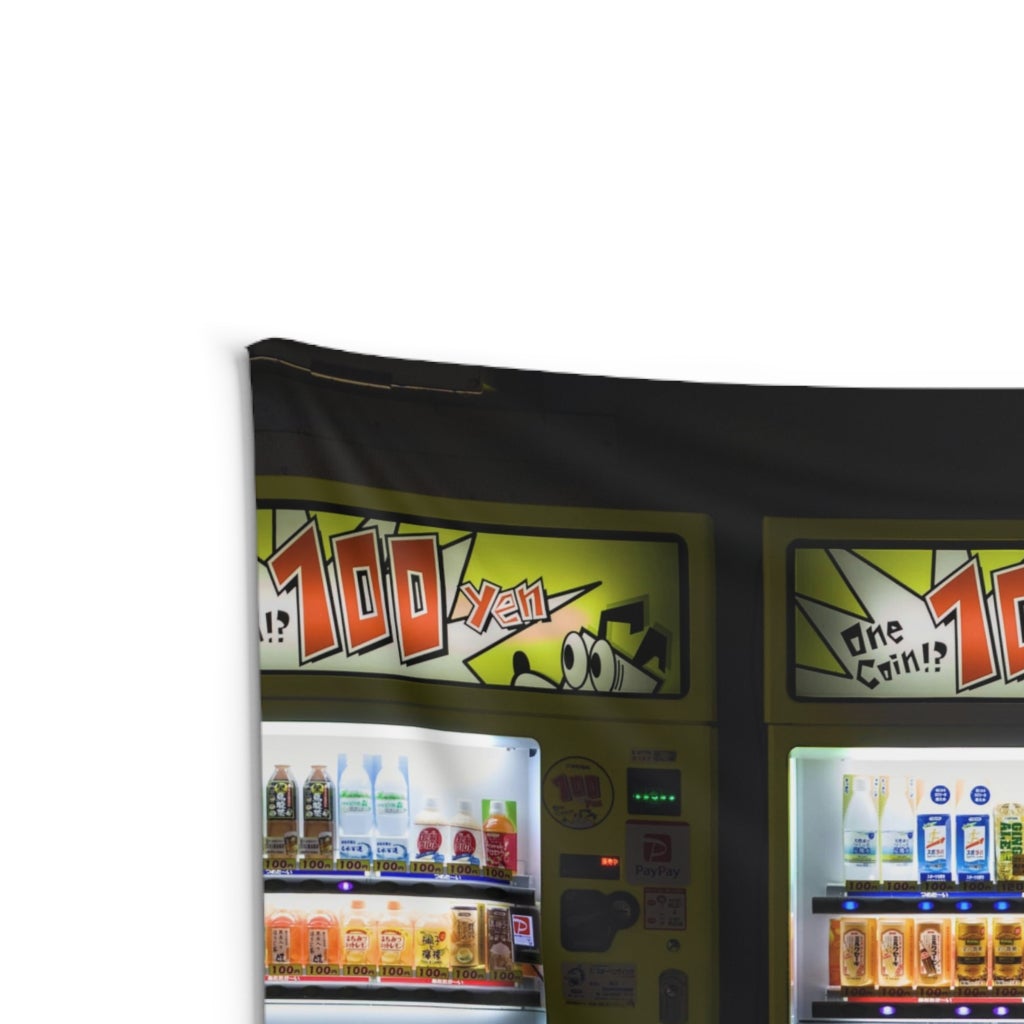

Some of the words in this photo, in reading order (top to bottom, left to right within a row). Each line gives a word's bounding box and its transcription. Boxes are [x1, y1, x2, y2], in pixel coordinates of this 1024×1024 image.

[266, 514, 448, 666] 100
[459, 576, 551, 634] yen
[841, 620, 904, 657] One
[856, 642, 947, 690] Coin!?
[635, 864, 681, 880] PayPay
